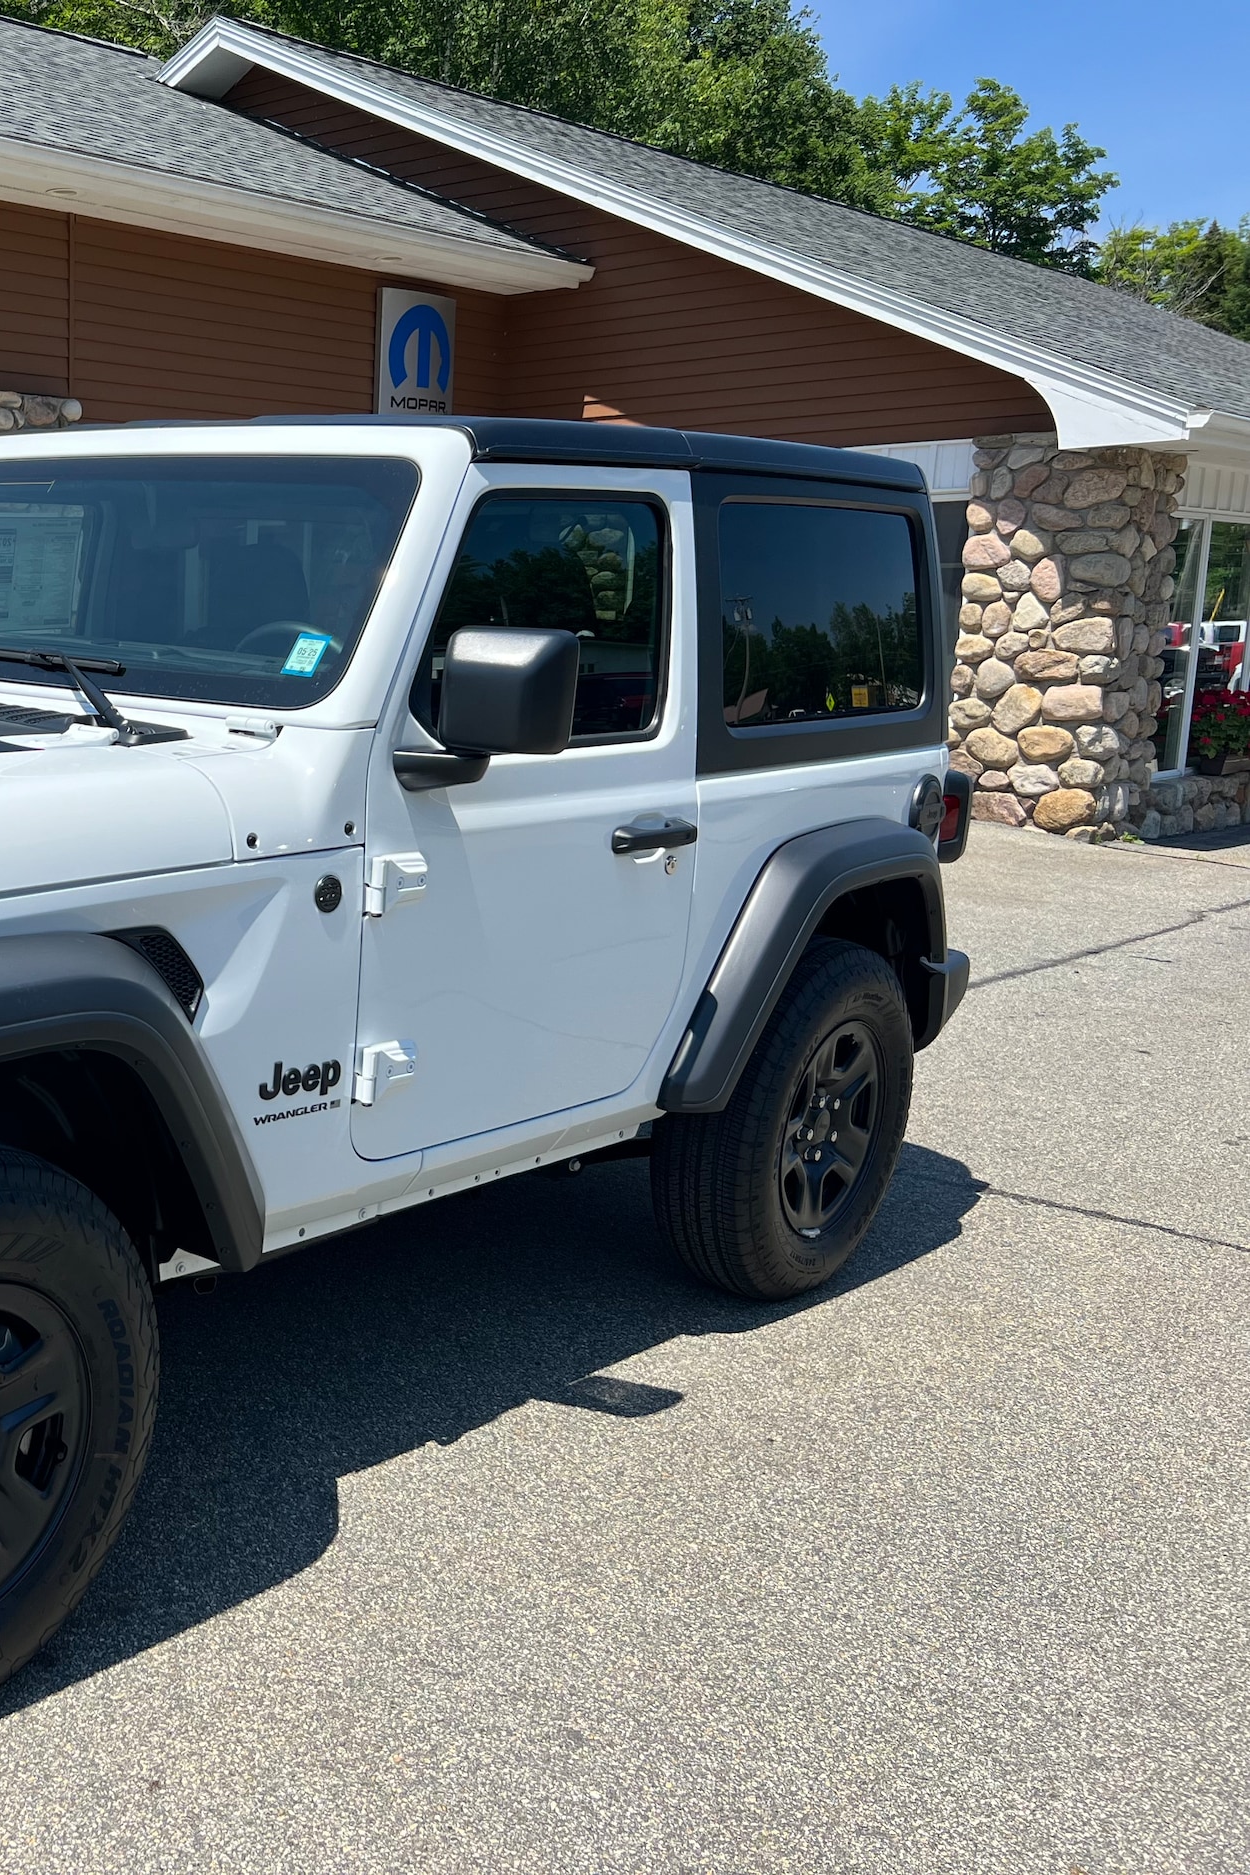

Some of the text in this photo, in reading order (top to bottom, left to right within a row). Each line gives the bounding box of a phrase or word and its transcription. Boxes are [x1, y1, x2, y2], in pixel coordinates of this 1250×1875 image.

[390, 395, 447, 414] MOPAR
[258, 1059, 342, 1101] Jeep
[253, 1101, 328, 1127] WRANGLER
[96, 1298, 136, 1456] ROADIAN
